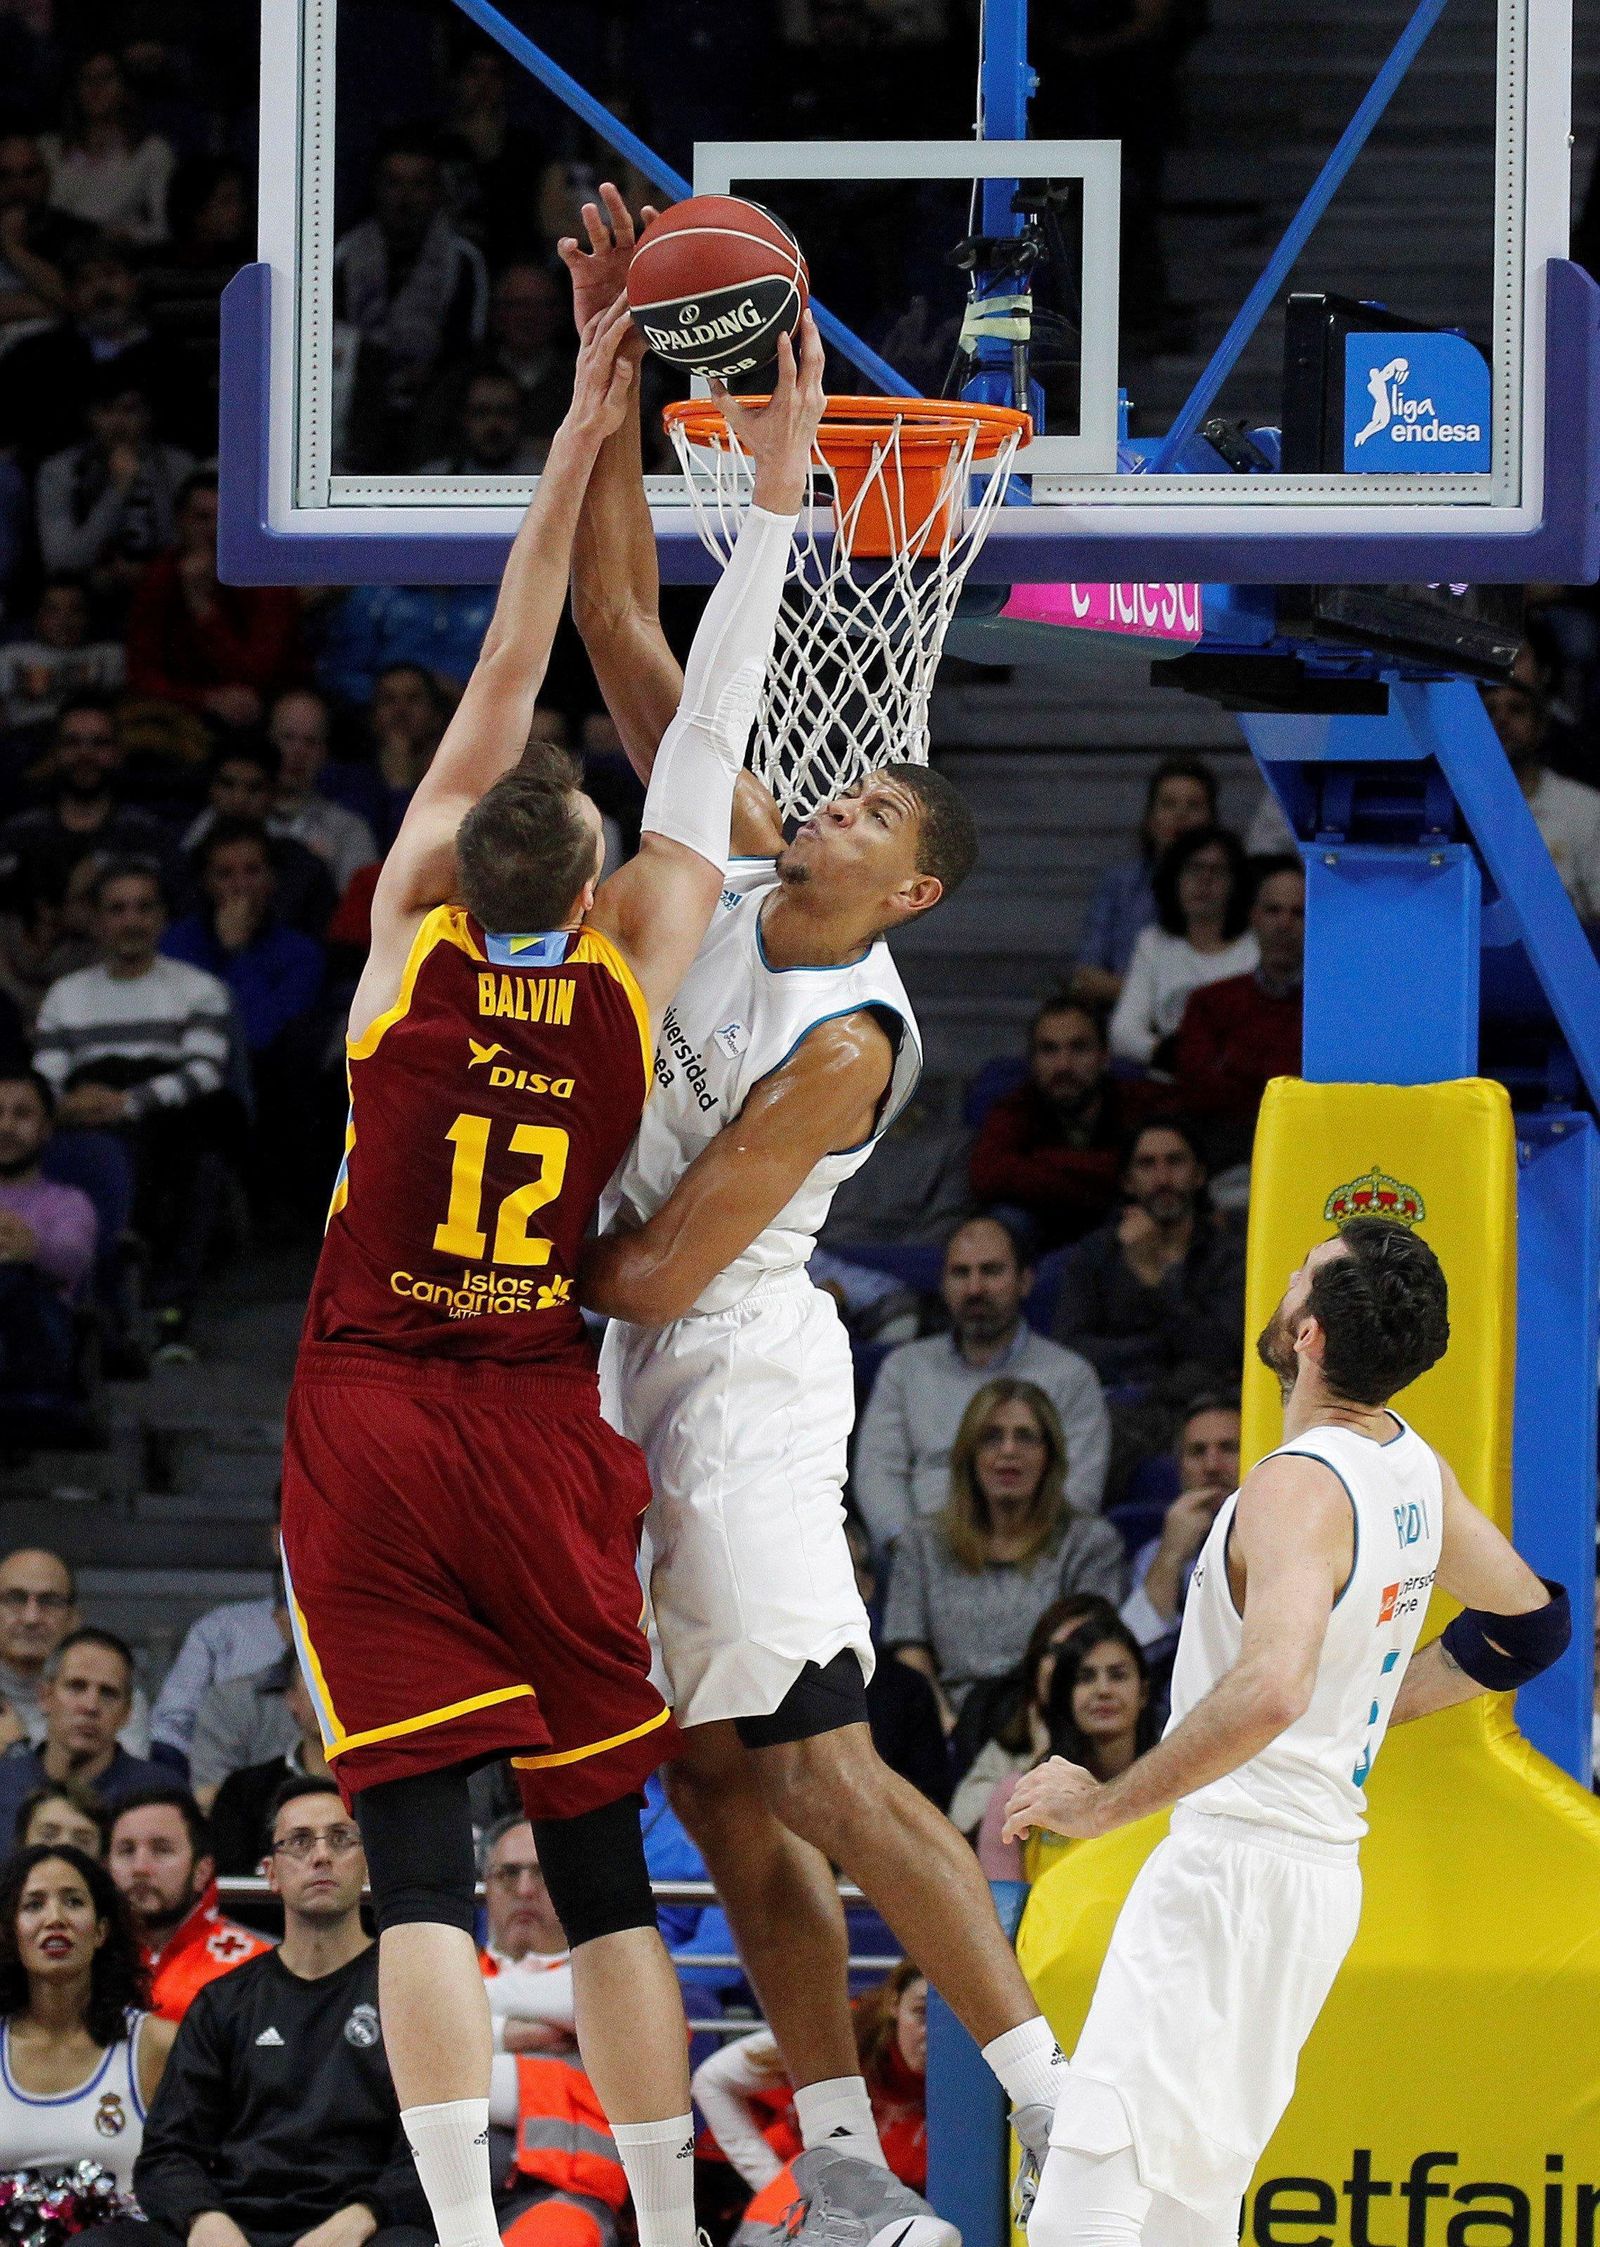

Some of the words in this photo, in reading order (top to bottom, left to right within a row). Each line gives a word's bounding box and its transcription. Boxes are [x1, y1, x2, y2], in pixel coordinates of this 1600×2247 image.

[644, 299, 760, 351] SPALDING
[1391, 384, 1435, 423] liga
[1391, 419, 1480, 441] endesa
[478, 972, 576, 1026] BALVIN
[662, 1005, 719, 1112] iversidad
[432, 1113, 569, 1266] 12
[390, 1271, 532, 1314] Canarias
[462, 1270, 534, 1295] Islas
[1238, 2149, 1600, 2247] etfair
